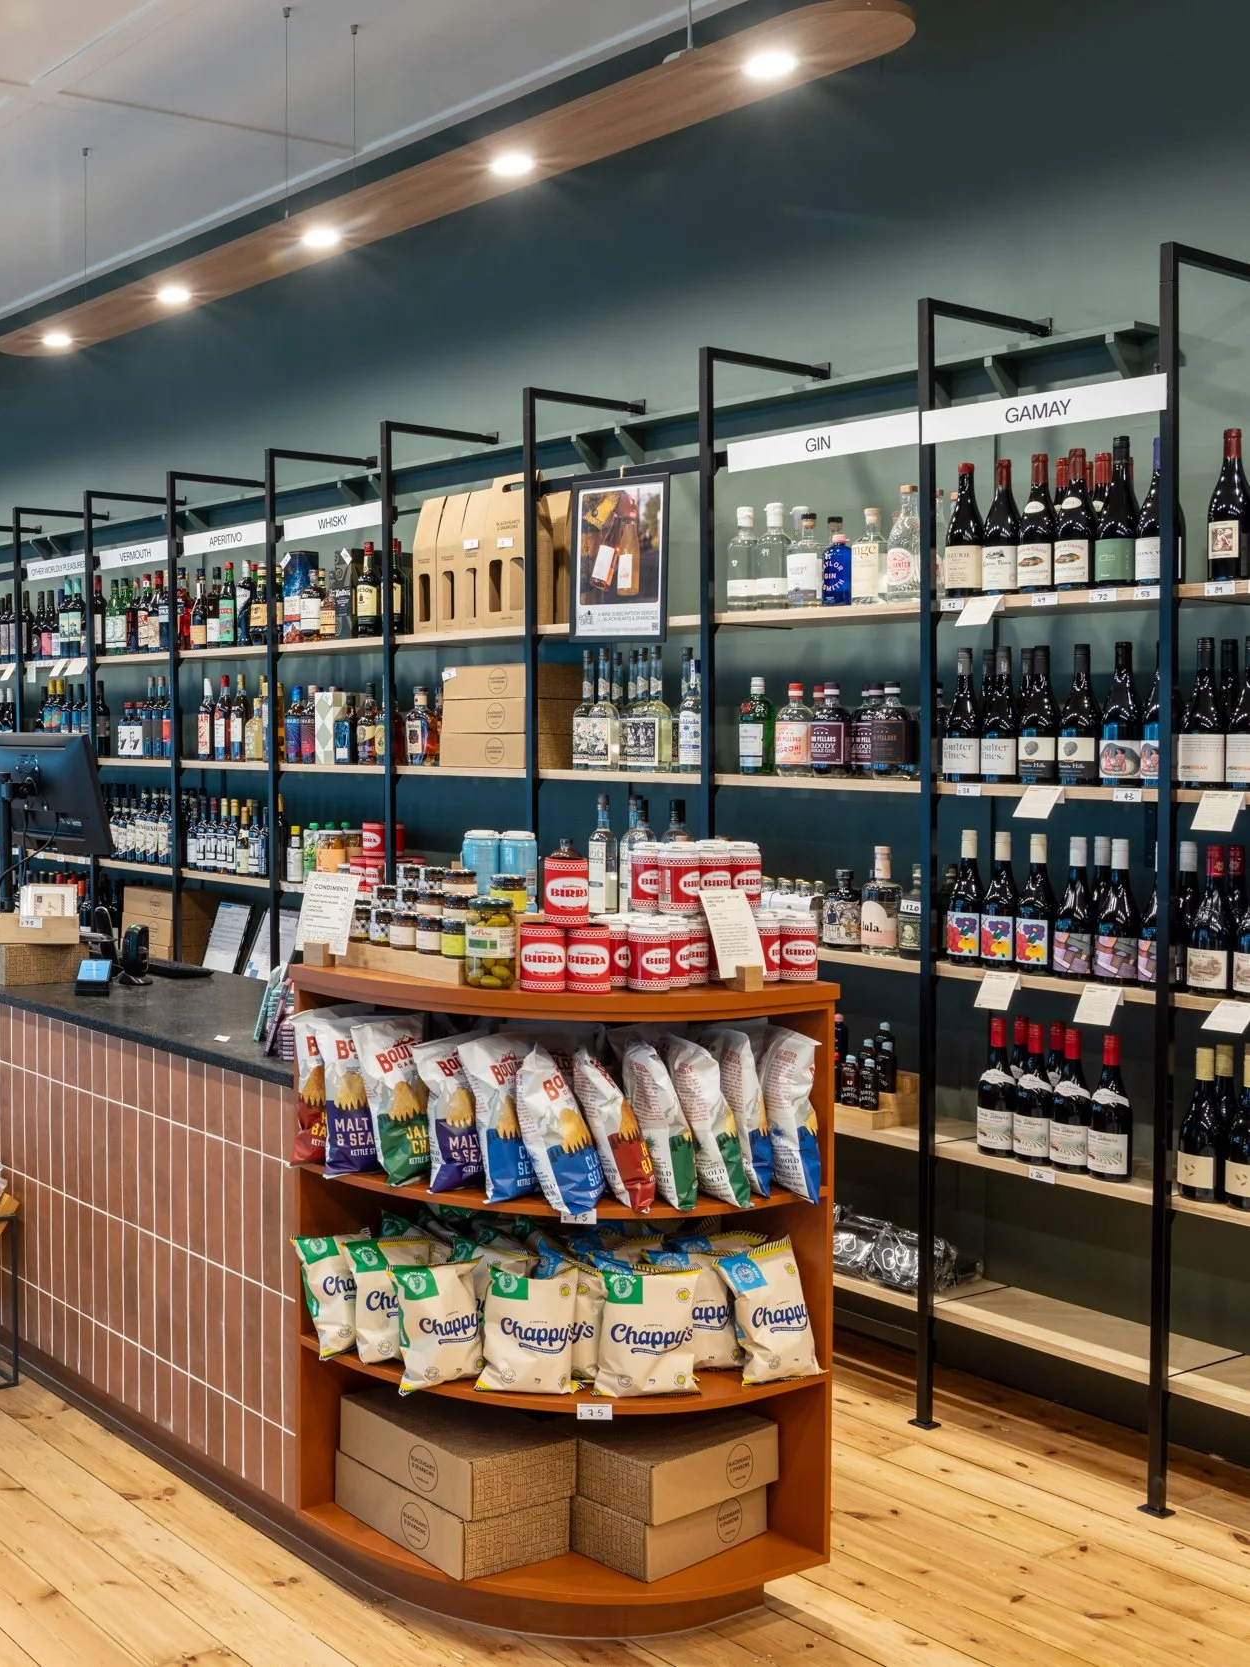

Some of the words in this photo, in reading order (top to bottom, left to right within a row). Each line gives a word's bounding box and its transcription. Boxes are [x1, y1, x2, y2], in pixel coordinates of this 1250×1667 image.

[1005, 399, 1071, 424] GAMAY
[805, 435, 831, 453] GIN
[317, 514, 349, 530] WHISKY
[209, 532, 242, 547] APERITIVO
[119, 548, 152, 562] VERMOUTH
[1097, 593, 1108, 601] 72
[817, 735, 836, 743] PILLARS
[314, 883, 349, 893] CONDIMENTS
[737, 878, 761, 886] BIRR
[550, 888, 588, 899] BIRRA
[906, 904, 919, 912] 120
[524, 954, 563, 964] BIRRA
[568, 954, 607, 965] BIRRA
[785, 947, 816, 957] BIRRA
[376, 1045, 414, 1074] BOUL
[335, 1117, 369, 1132] MALT
[337, 1135, 344, 1146] &
[350, 1131, 374, 1145] SEA
[351, 1148, 368, 1156] KETTLE
[752, 1303, 808, 1329] Chappy
[419, 1312, 479, 1339] Chappy
[500, 1317, 575, 1348] Chappy's
[610, 1323, 693, 1349] Chappy's
[410, 1454, 436, 1472] BLACKHEARTS
